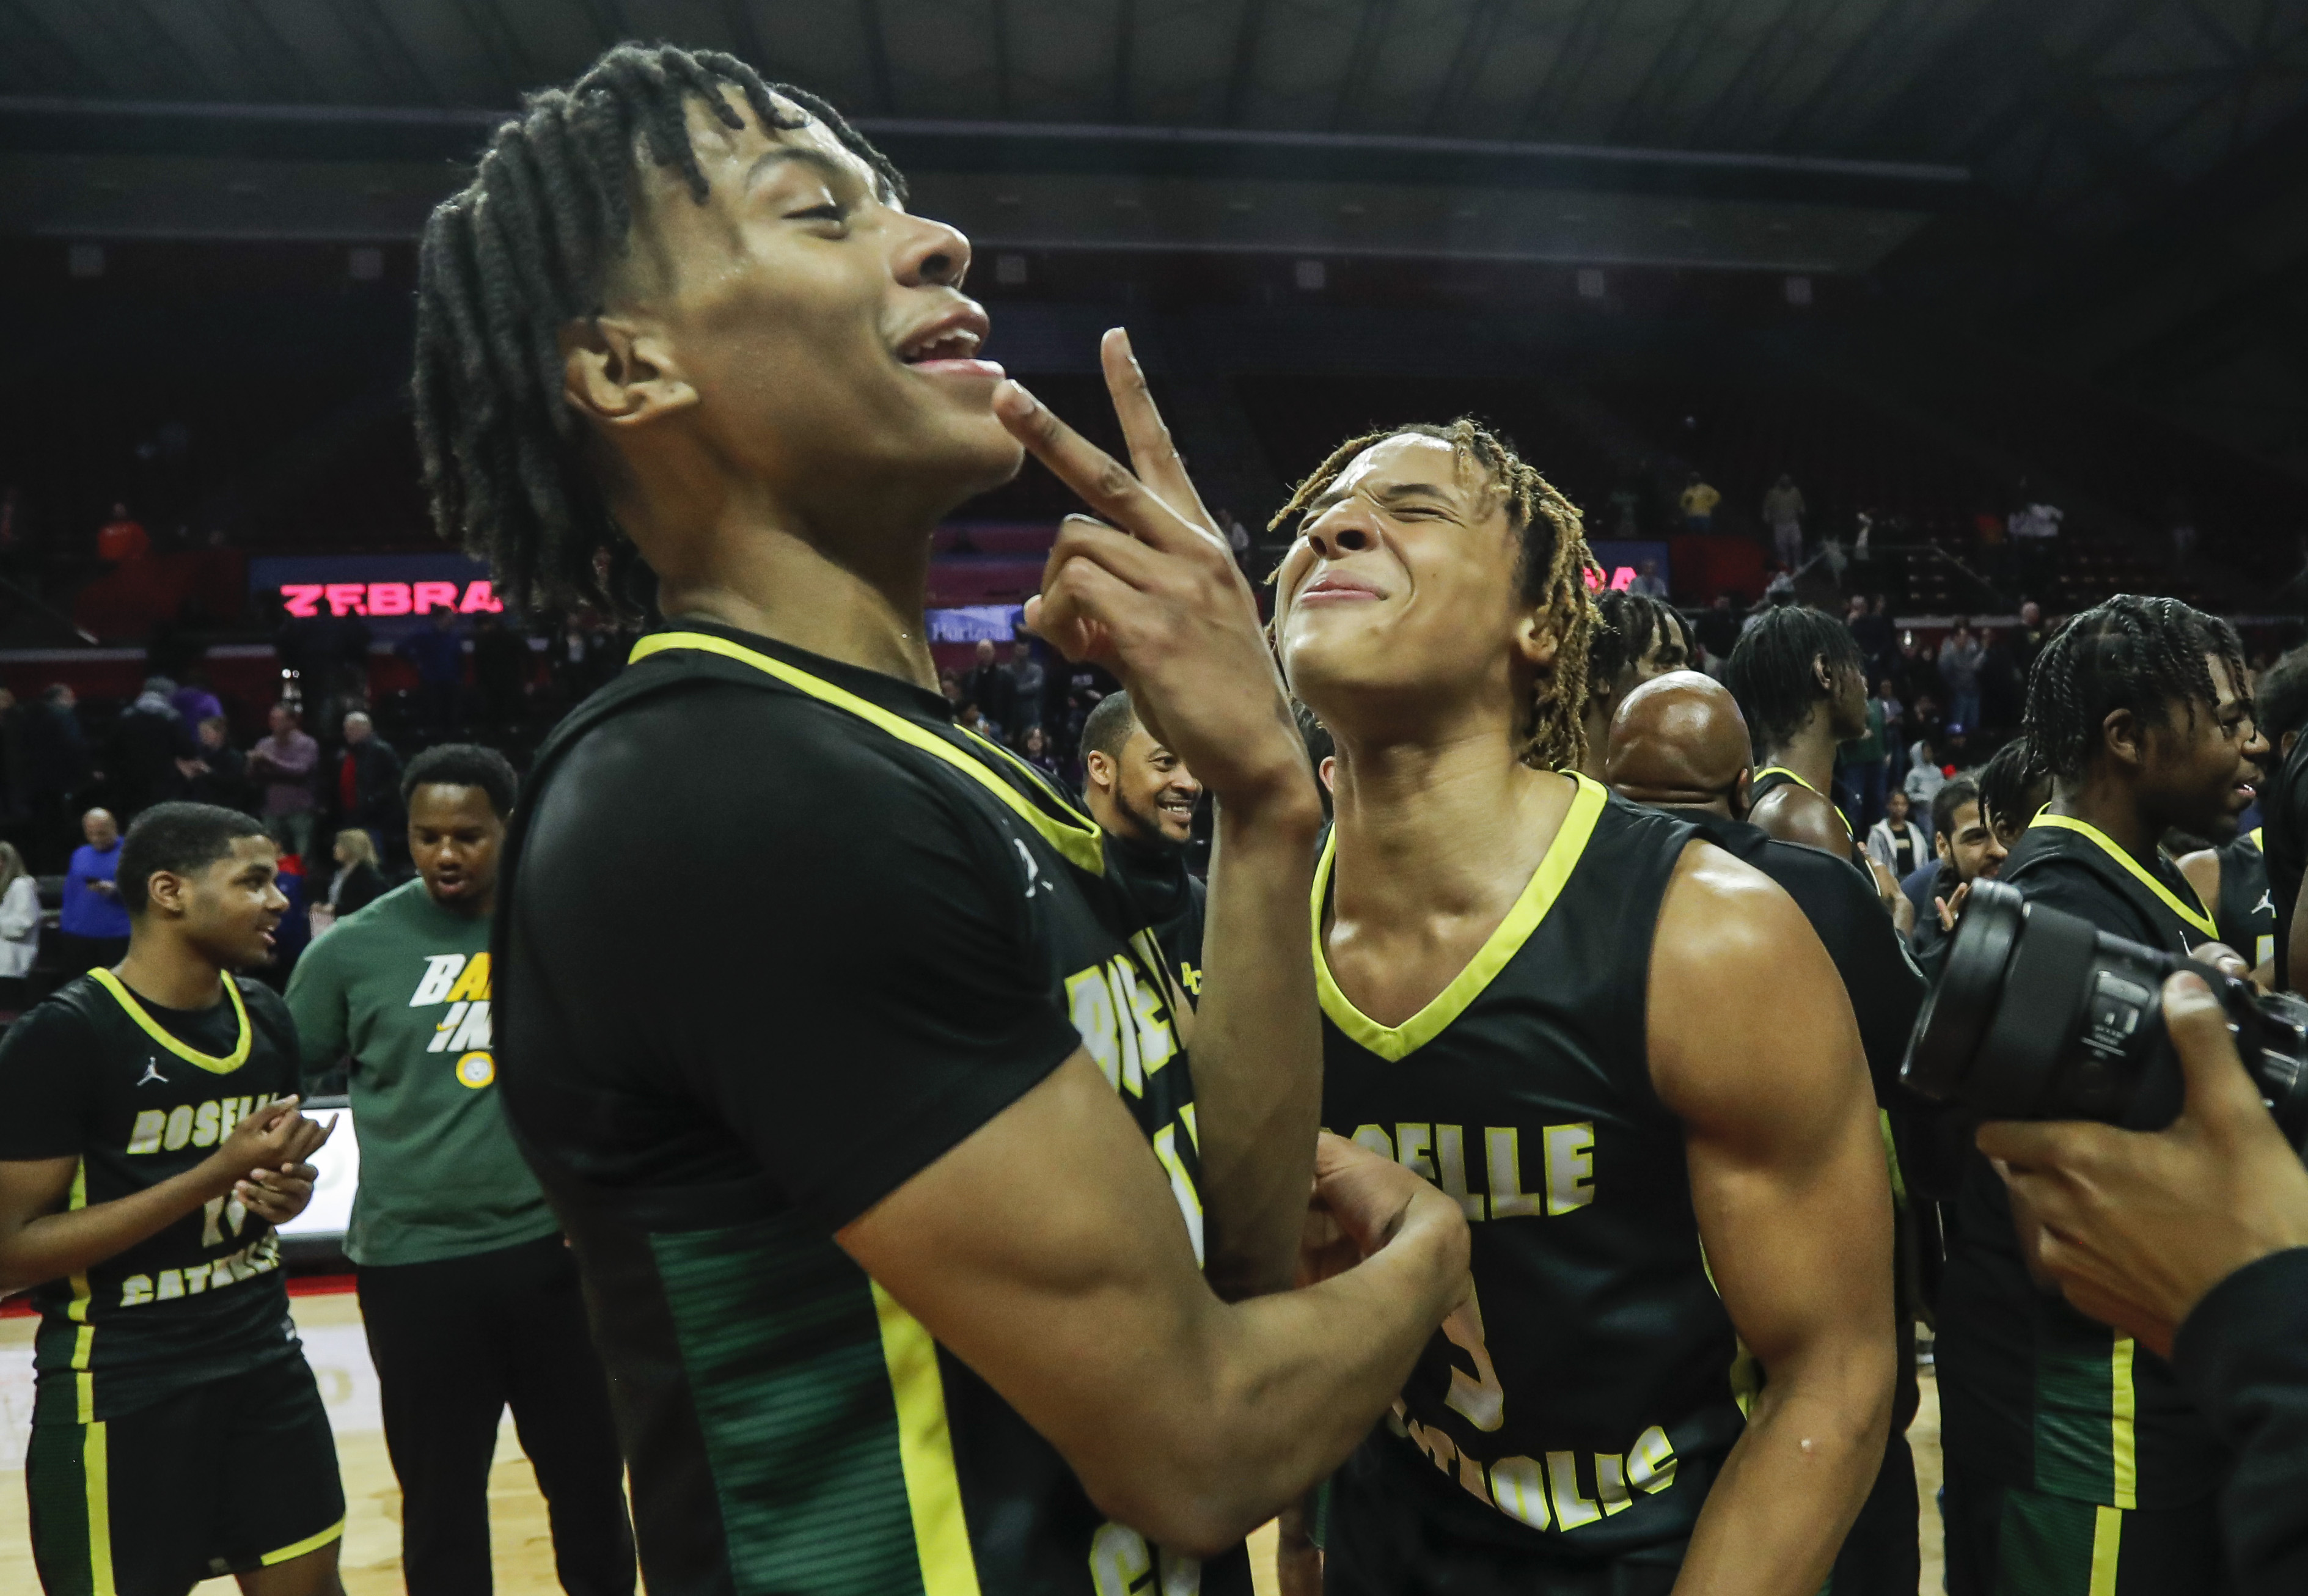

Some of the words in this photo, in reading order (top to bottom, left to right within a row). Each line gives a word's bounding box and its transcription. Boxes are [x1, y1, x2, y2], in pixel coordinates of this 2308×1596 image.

[280, 580, 503, 617] ZEBRA
[409, 951, 492, 1007] BA
[126, 1093, 279, 1154] ROSE
[1322, 1121, 1595, 1221] ELLE
[1388, 1400, 1679, 1533] OLIC
